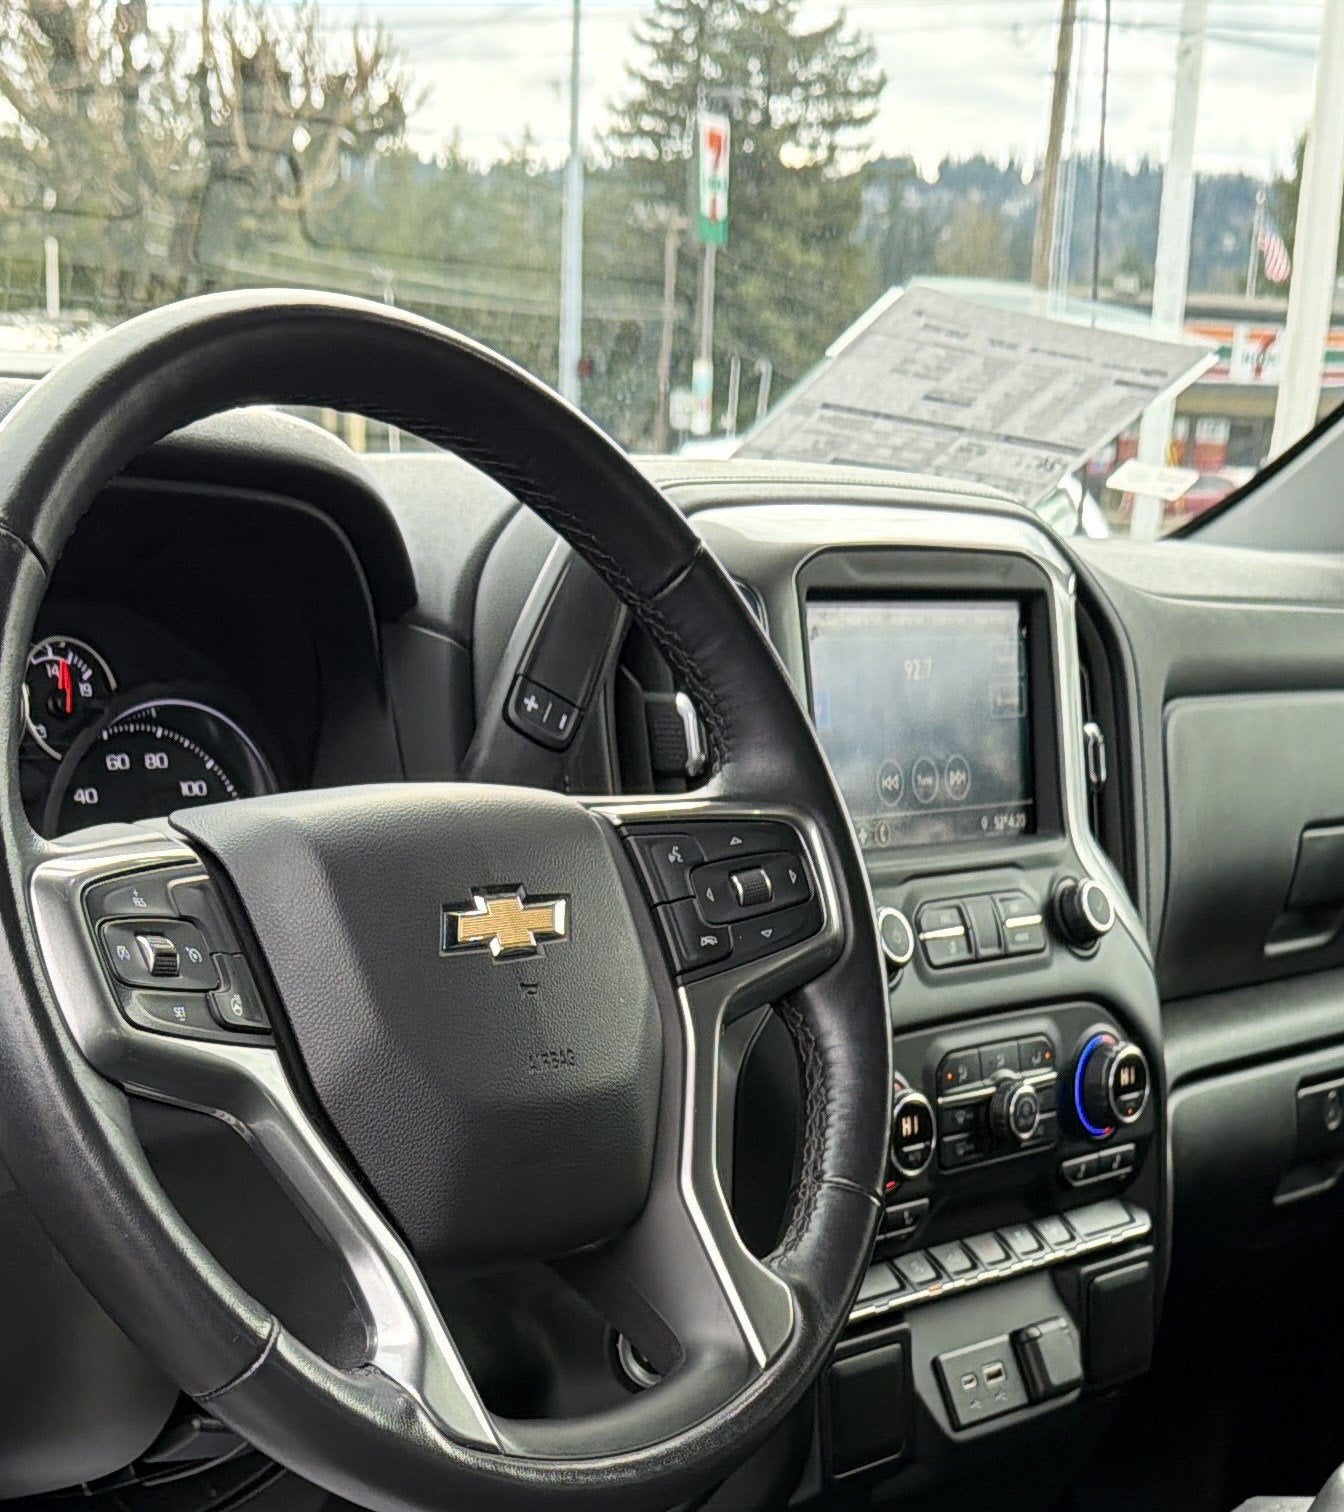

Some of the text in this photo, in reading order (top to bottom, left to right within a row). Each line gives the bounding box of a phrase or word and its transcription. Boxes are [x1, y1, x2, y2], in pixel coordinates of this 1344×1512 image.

[78, 681, 93, 698] 19
[105, 753, 130, 771] 60
[143, 752, 169, 770] 80
[73, 787, 99, 805] 40
[179, 780, 207, 797] 100
[1119, 1066, 1136, 1087] HI
[901, 1115, 919, 1138] HI
